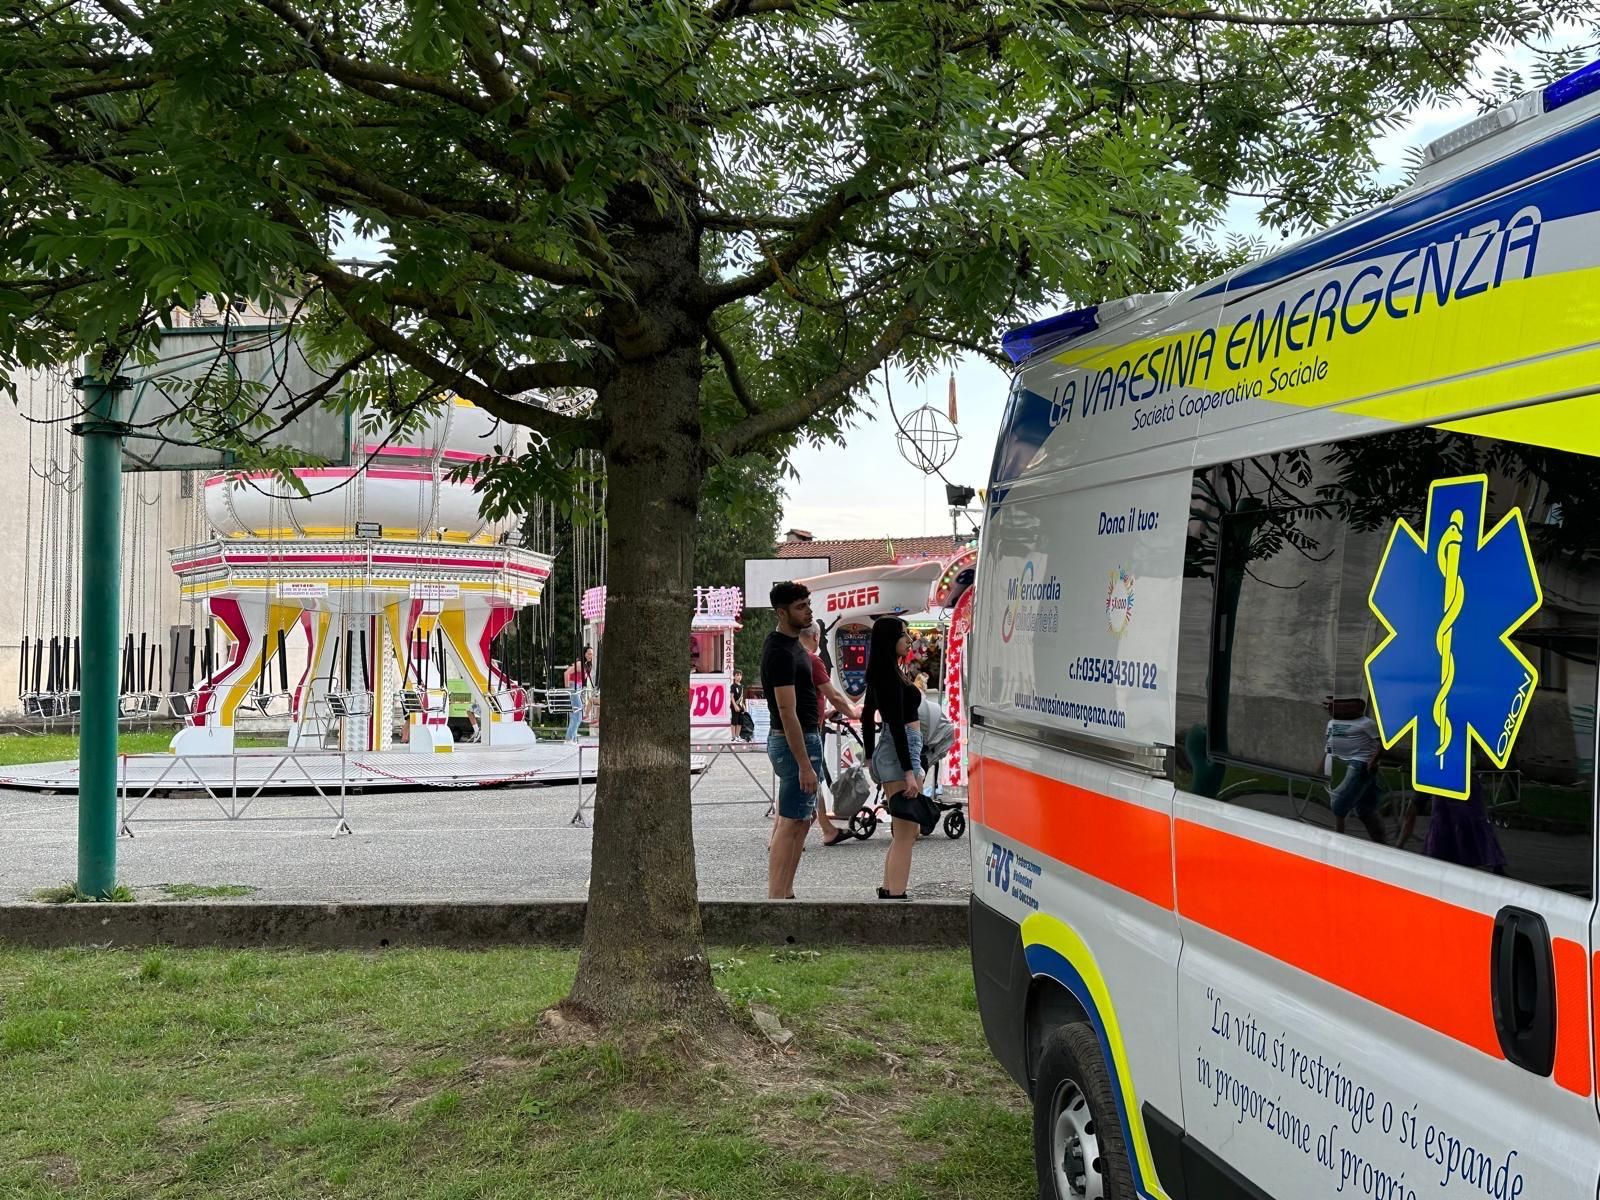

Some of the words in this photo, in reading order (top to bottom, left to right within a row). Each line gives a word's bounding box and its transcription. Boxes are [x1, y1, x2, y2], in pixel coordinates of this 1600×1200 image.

[1049, 380, 1076, 428] LA
[1082, 328, 1216, 419] VARESINA
[1225, 205, 1542, 371] EMERGENZA
[1131, 401, 1175, 431] Società
[1179, 378, 1263, 419] Cooperativa
[1267, 355, 1329, 394] Sociale
[1098, 511, 1126, 535] Dona
[1128, 507, 1136, 532] il
[1137, 509, 1159, 531] tuo:
[827, 585, 880, 612] BOXER
[690, 685, 725, 716] BO
[1069, 657, 1157, 690] c.f:03543430122
[1014, 690, 1126, 728] www.lavaresinaemergenza.com
[1497, 672, 1532, 757] ORION
[1197, 1045, 1211, 1088] in
[1213, 1067, 1310, 1153] proporzione
[1317, 1124, 1338, 1170] al
[1235, 1012, 1267, 1062] vita
[1272, 1032, 1286, 1072] si
[1290, 1047, 1375, 1134] restringe
[1382, 1101, 1393, 1133] o
[1399, 1103, 1418, 1149] si
[1424, 1124, 1523, 1200] espande
